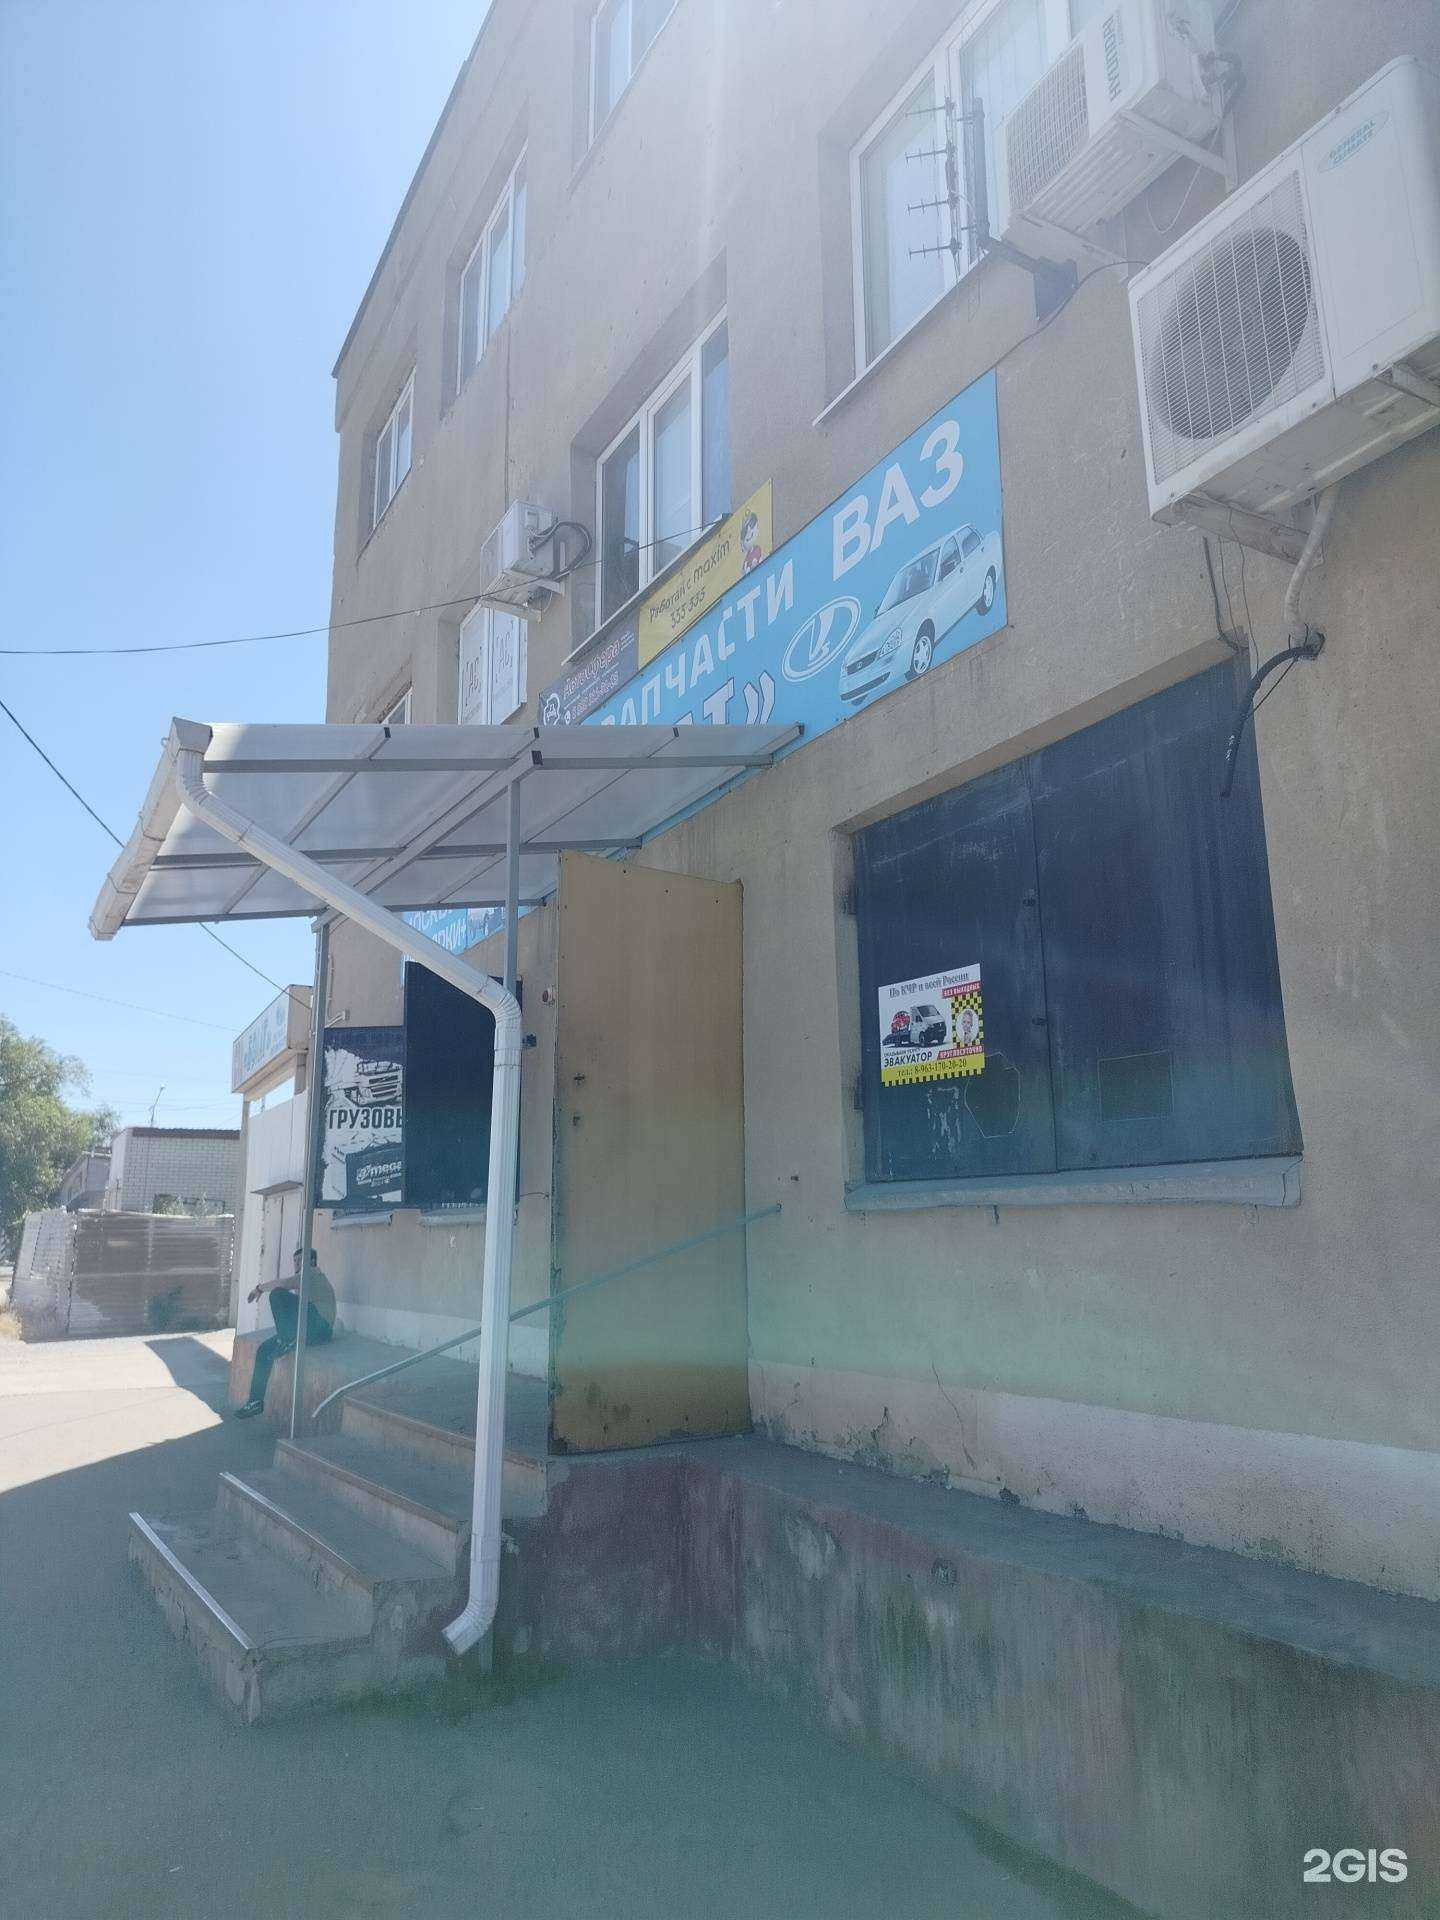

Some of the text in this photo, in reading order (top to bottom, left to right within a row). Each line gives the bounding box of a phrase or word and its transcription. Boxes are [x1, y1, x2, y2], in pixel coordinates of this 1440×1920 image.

[602, 419, 964, 726] АПЧАСТИ ВАЗ
[693, 540, 730, 582] maxim
[884, 1051, 932, 1068] ЭВАКУАТОР
